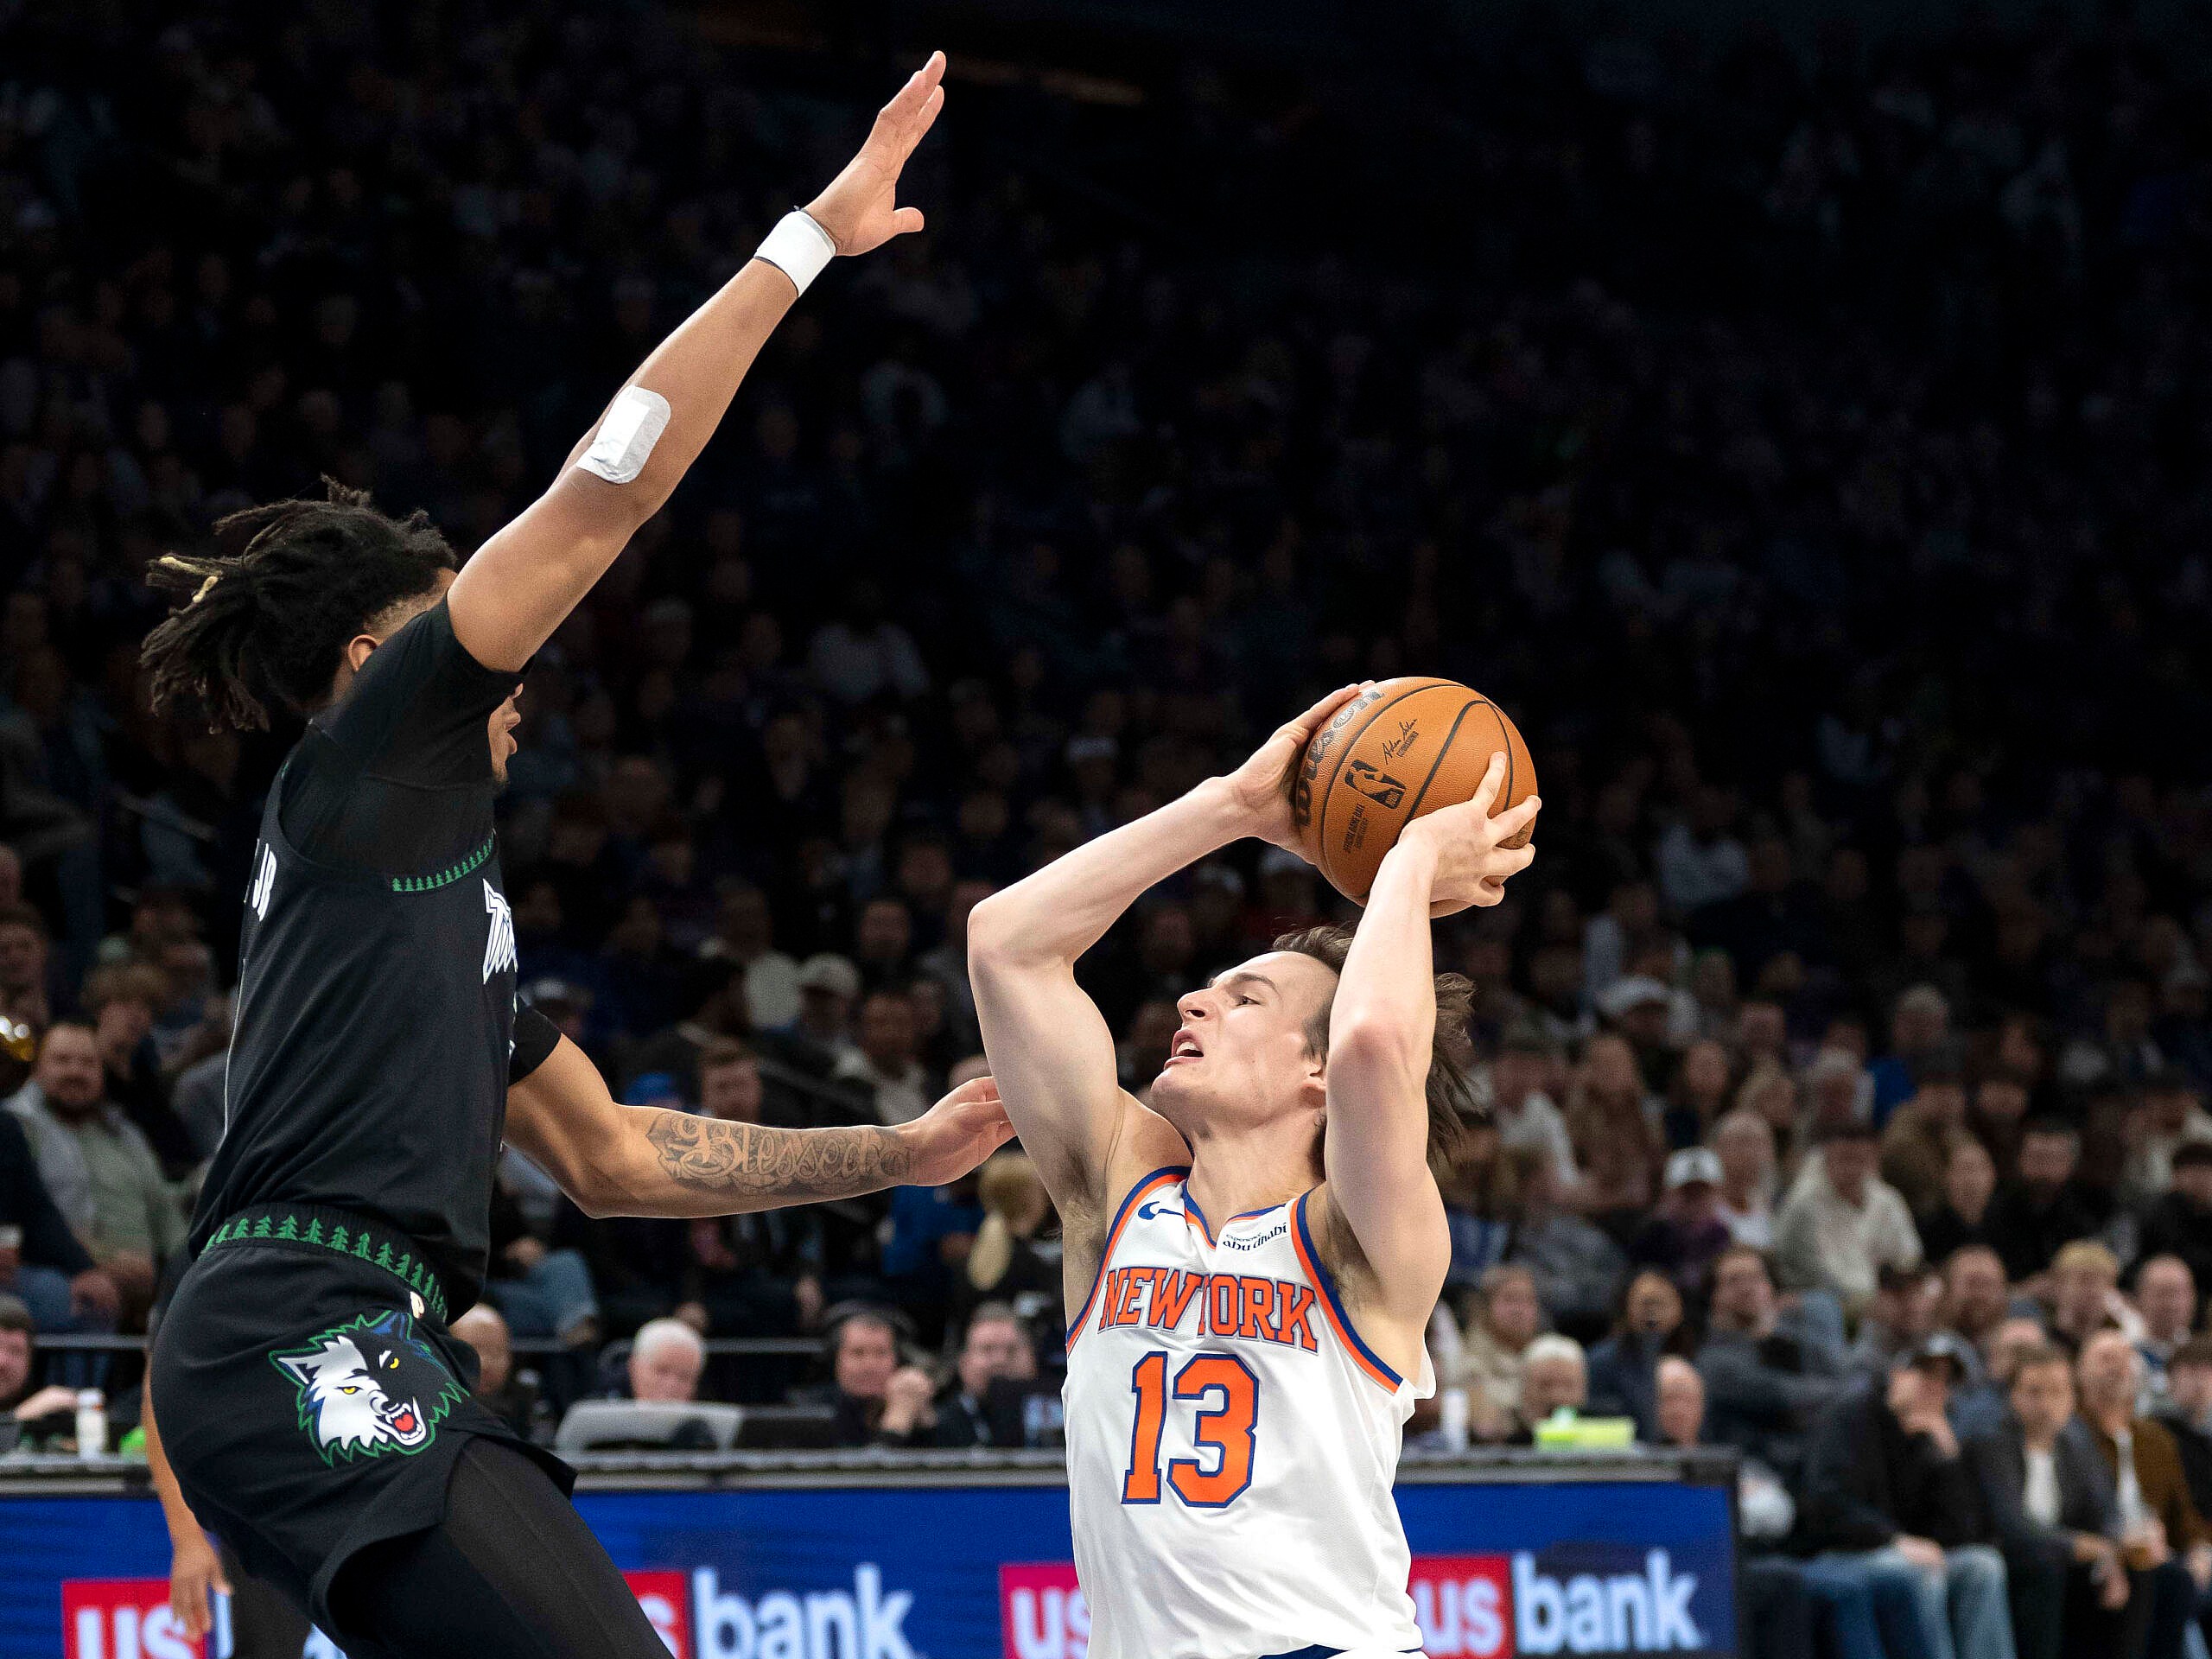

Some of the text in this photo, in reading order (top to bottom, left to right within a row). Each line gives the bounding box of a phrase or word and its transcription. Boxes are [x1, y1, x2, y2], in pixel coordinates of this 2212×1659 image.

[1222, 1239, 1251, 1252] abu
[1097, 1266, 1204, 1334] NEW
[1121, 1350, 1260, 1509] 13
[692, 1562, 930, 1659] bank
[1511, 1547, 1702, 1656] bank
